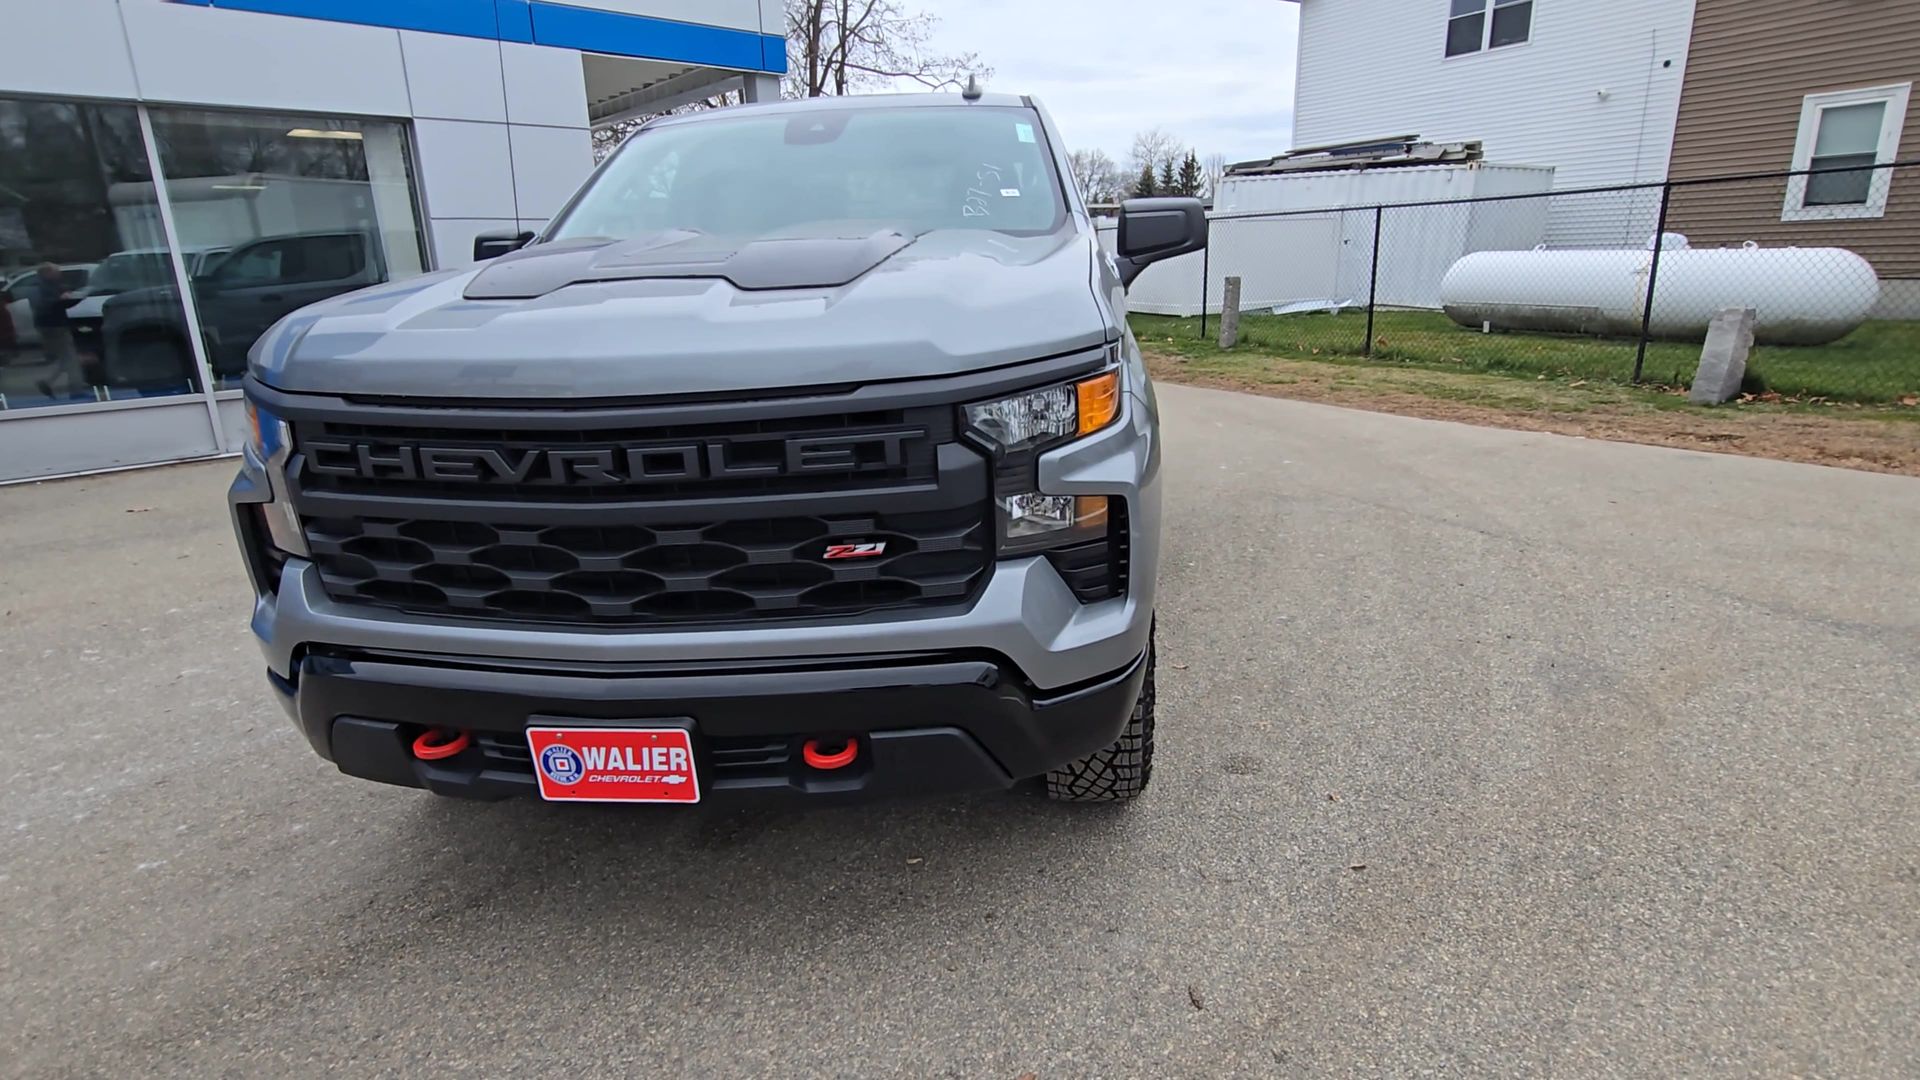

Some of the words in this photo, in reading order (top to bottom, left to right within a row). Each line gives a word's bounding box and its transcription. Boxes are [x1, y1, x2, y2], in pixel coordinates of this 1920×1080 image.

[304, 429, 926, 482] CHEVROLET
[822, 541, 887, 559] Z71
[582, 747, 687, 771] WALIER
